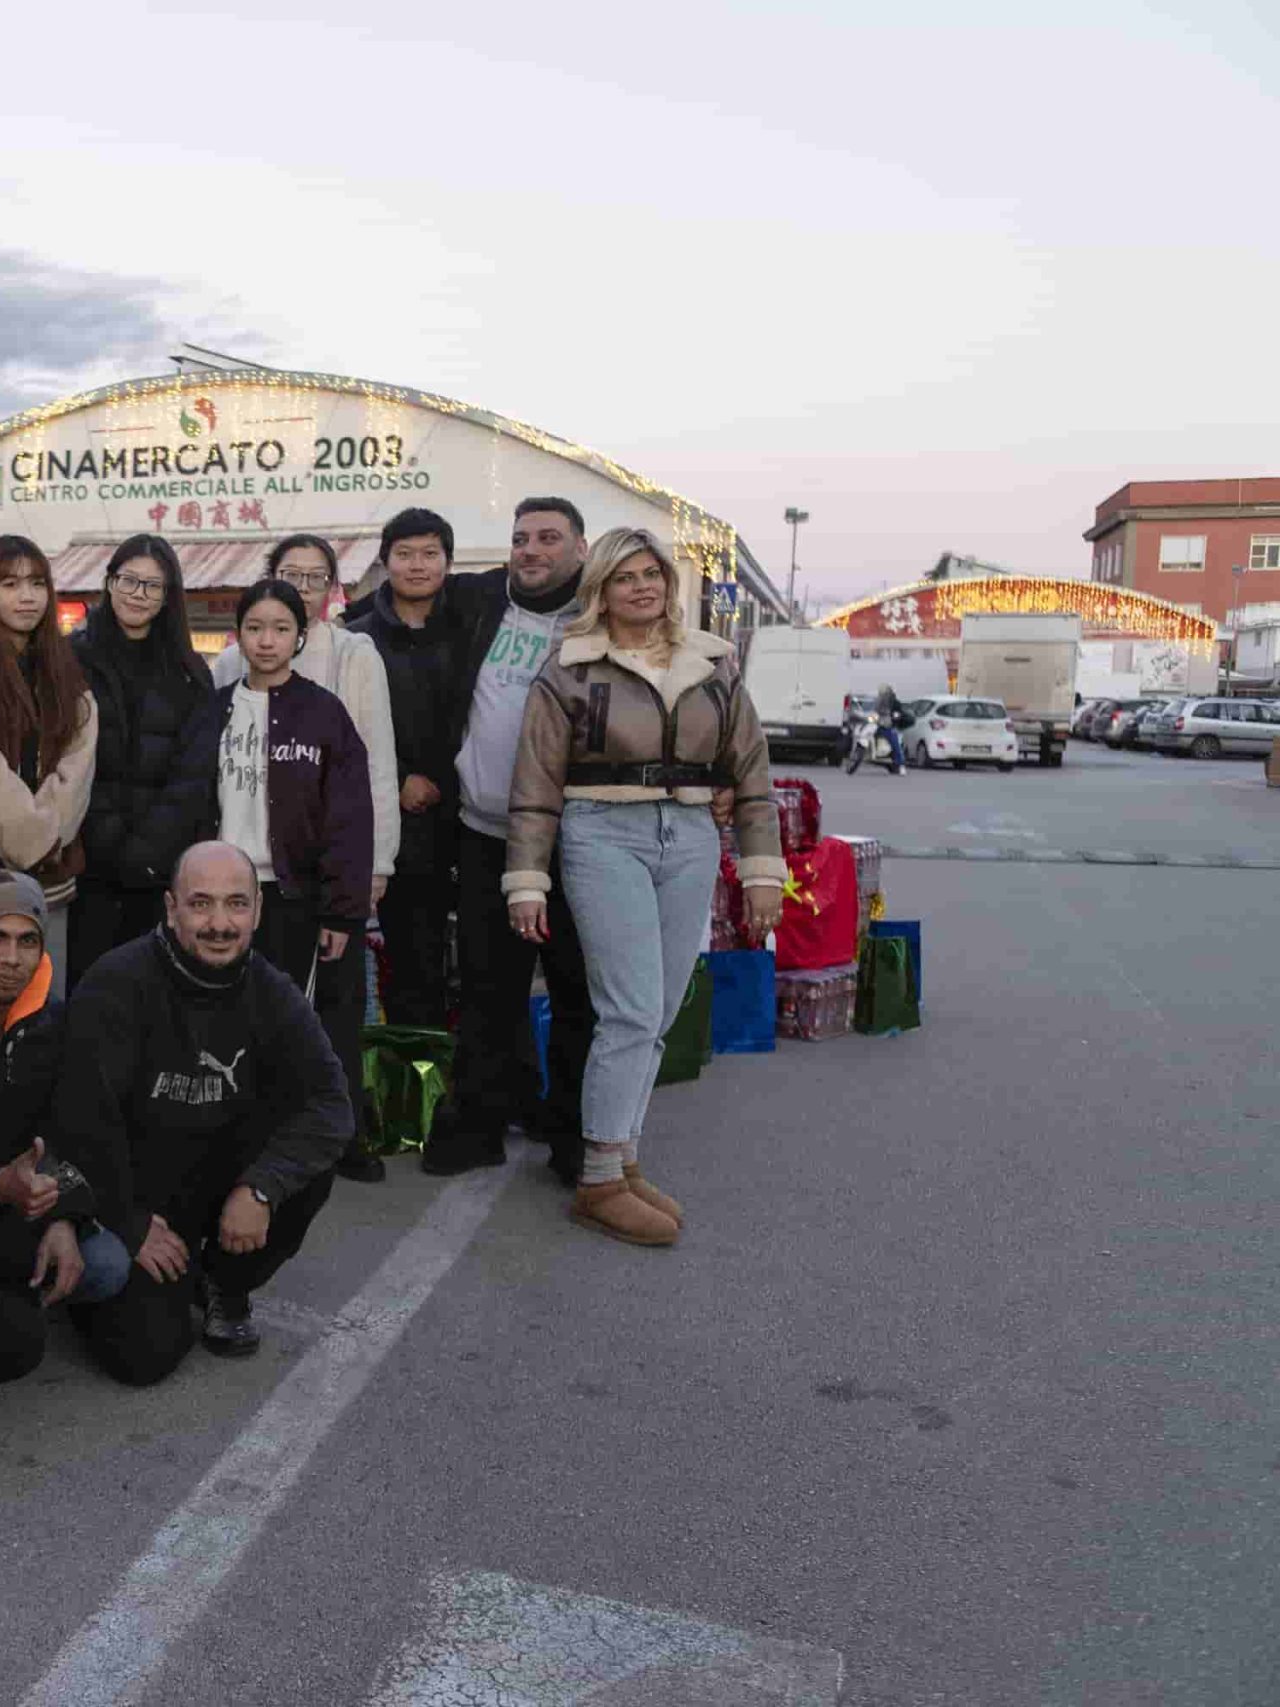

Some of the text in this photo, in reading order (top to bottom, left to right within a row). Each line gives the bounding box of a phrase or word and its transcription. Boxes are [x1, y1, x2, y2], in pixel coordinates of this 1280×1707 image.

[11, 435, 403, 482] CINAMERCATO 2003
[10, 484, 88, 503] CENTRO
[98, 477, 255, 500] COMMERCIALE
